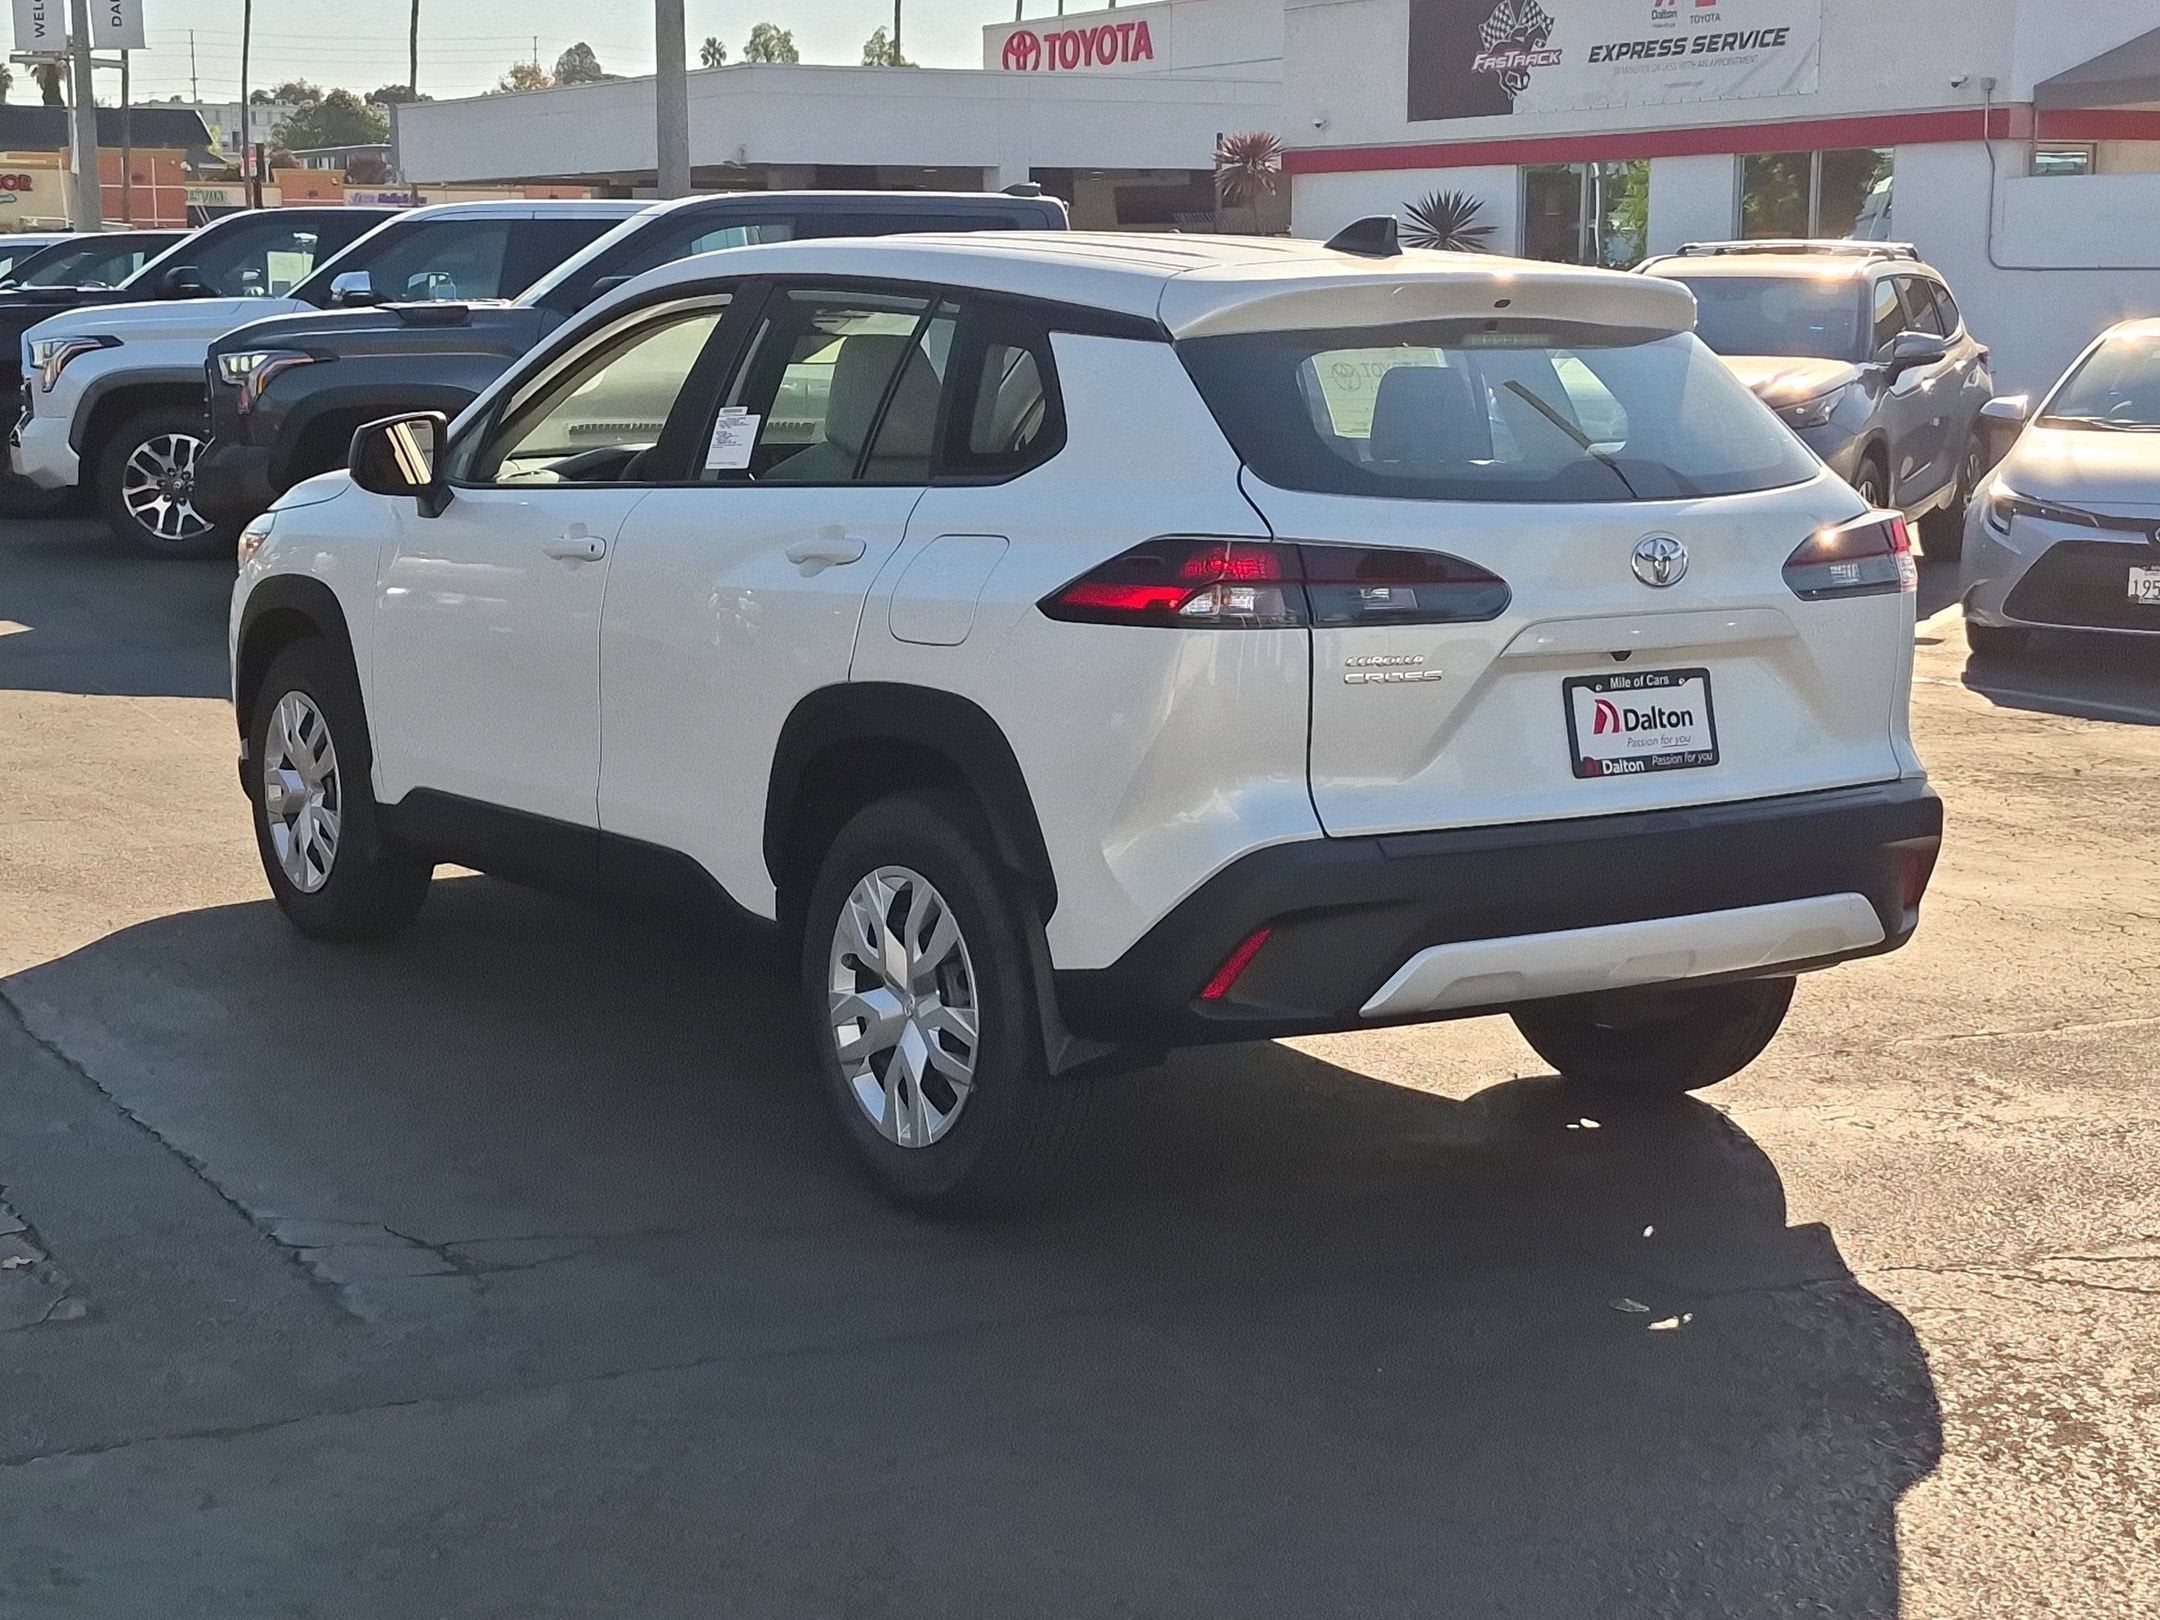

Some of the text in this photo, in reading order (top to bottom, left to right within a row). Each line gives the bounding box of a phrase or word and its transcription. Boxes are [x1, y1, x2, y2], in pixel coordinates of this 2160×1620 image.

[33, 0, 45, 38] WEL
[110, 0, 122, 27] DA
[1689, 13, 1721, 24] TOYOTA
[1043, 20, 1154, 71] TOYOTA
[1588, 26, 1790, 63] EXPRESS SERVICE
[0, 174, 33, 192] OR
[1345, 654, 1424, 667] COROLLA
[1344, 669, 1443, 685] CROSS
[1609, 674, 1670, 689] Mile of Cars
[1623, 705, 1694, 732] Dalton
[1627, 735, 1692, 748] Passion for you
[1602, 751, 1713, 775] Dalton Passion for you
